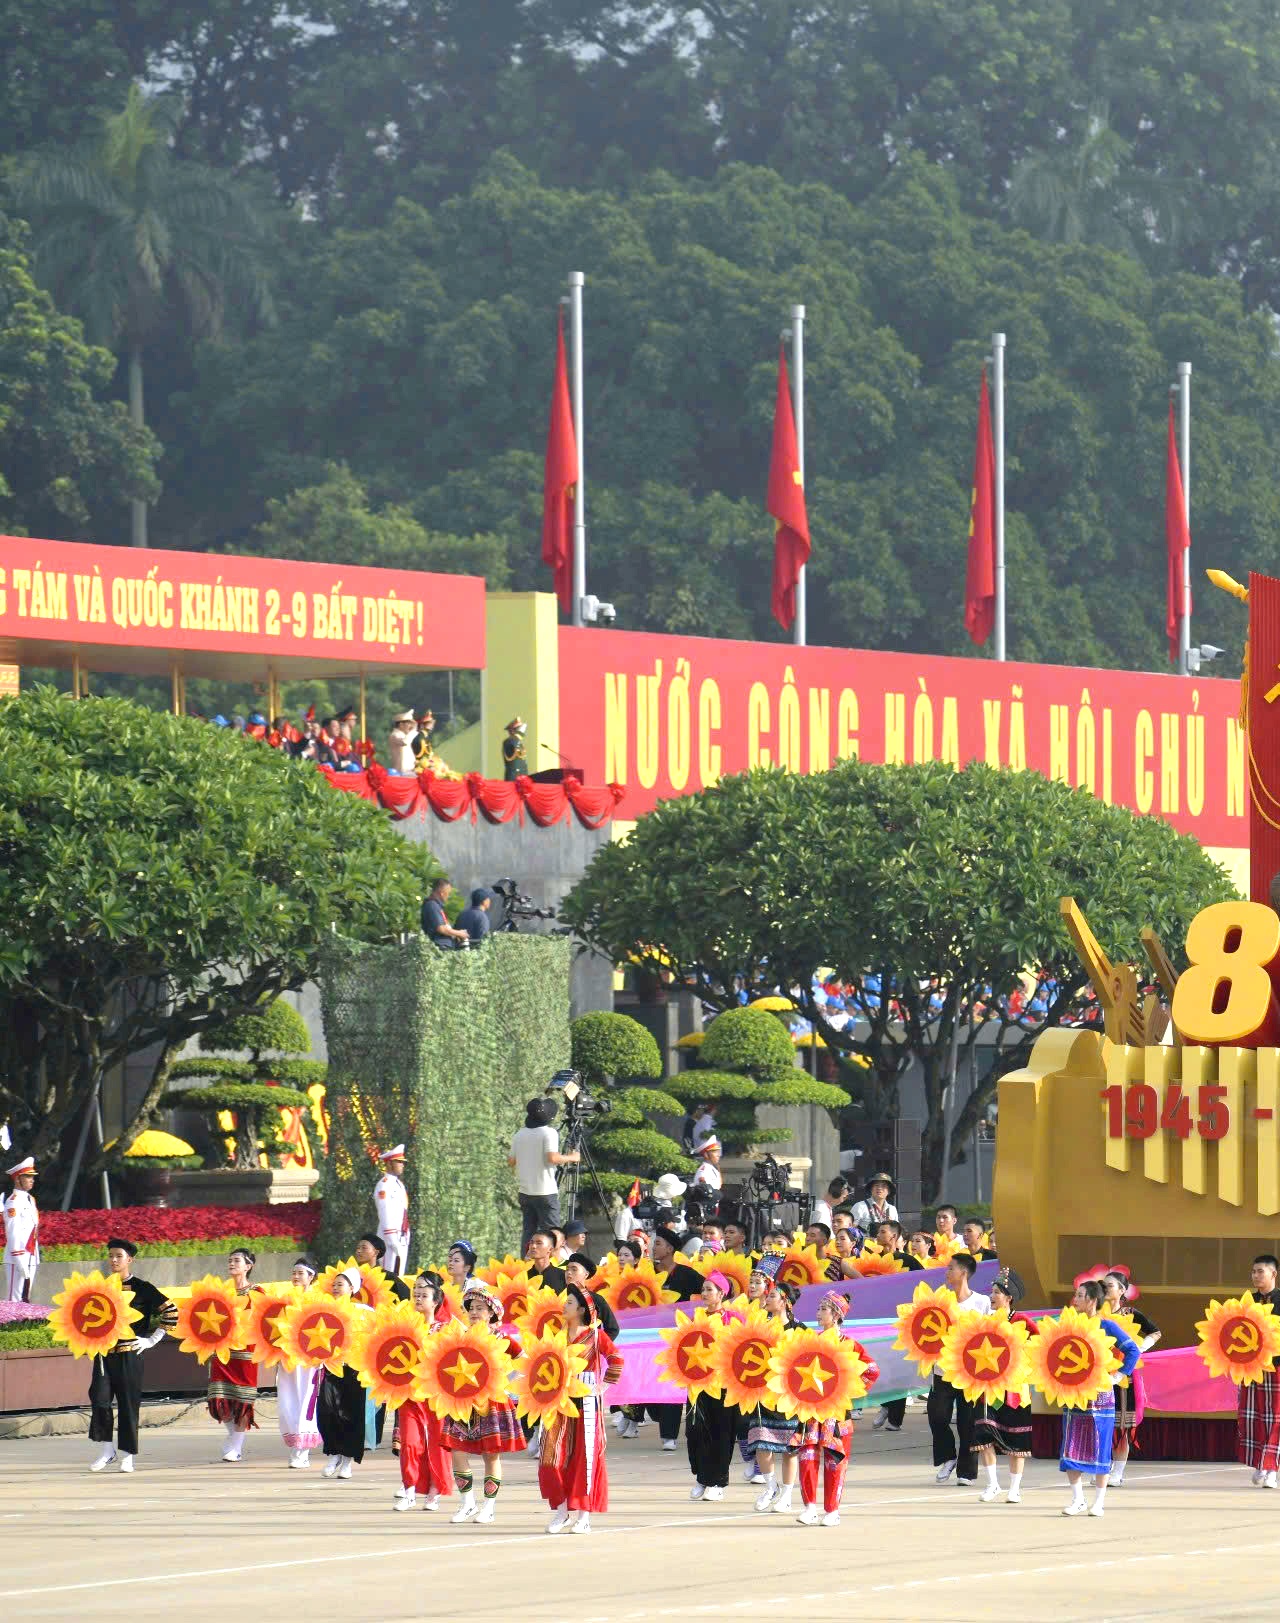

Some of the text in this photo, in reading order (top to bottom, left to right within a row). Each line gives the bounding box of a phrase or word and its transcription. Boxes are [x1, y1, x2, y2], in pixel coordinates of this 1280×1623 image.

[13, 560, 68, 620] TÁM
[73, 564, 107, 623] VÀ
[112, 565, 173, 629] QUỐC
[180, 575, 259, 634] KHÁNH
[265, 588, 307, 638] 2-9
[312, 580, 357, 641] BẤT
[363, 589, 423, 653] DIỆT!
[605, 657, 721, 790] NƯỚC
[885, 677, 959, 773] HÒA
[983, 685, 1026, 772] XÃ
[1135, 689, 1204, 816] CHỦ
[1101, 1084, 1231, 1141] 1945
